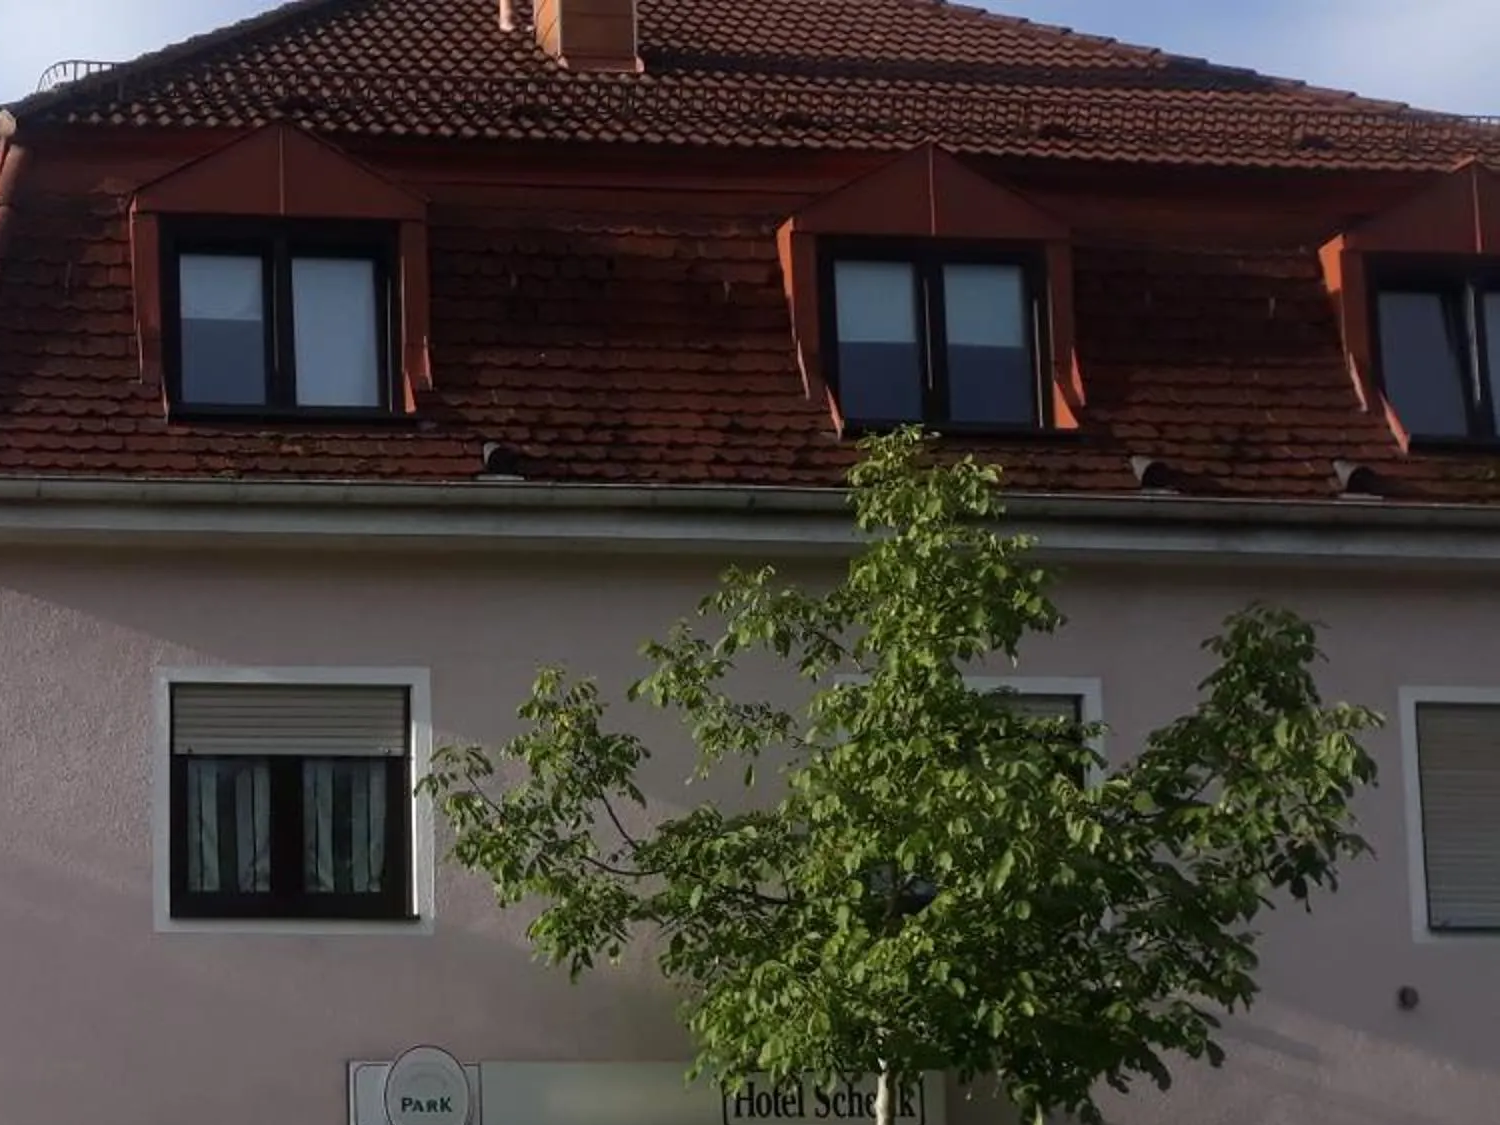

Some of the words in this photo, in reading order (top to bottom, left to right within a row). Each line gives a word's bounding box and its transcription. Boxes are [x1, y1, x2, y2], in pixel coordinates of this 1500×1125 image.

[401, 1096, 453, 1113] PARK
[734, 1080, 806, 1118] Hotel
[814, 1082, 917, 1118] Schek
